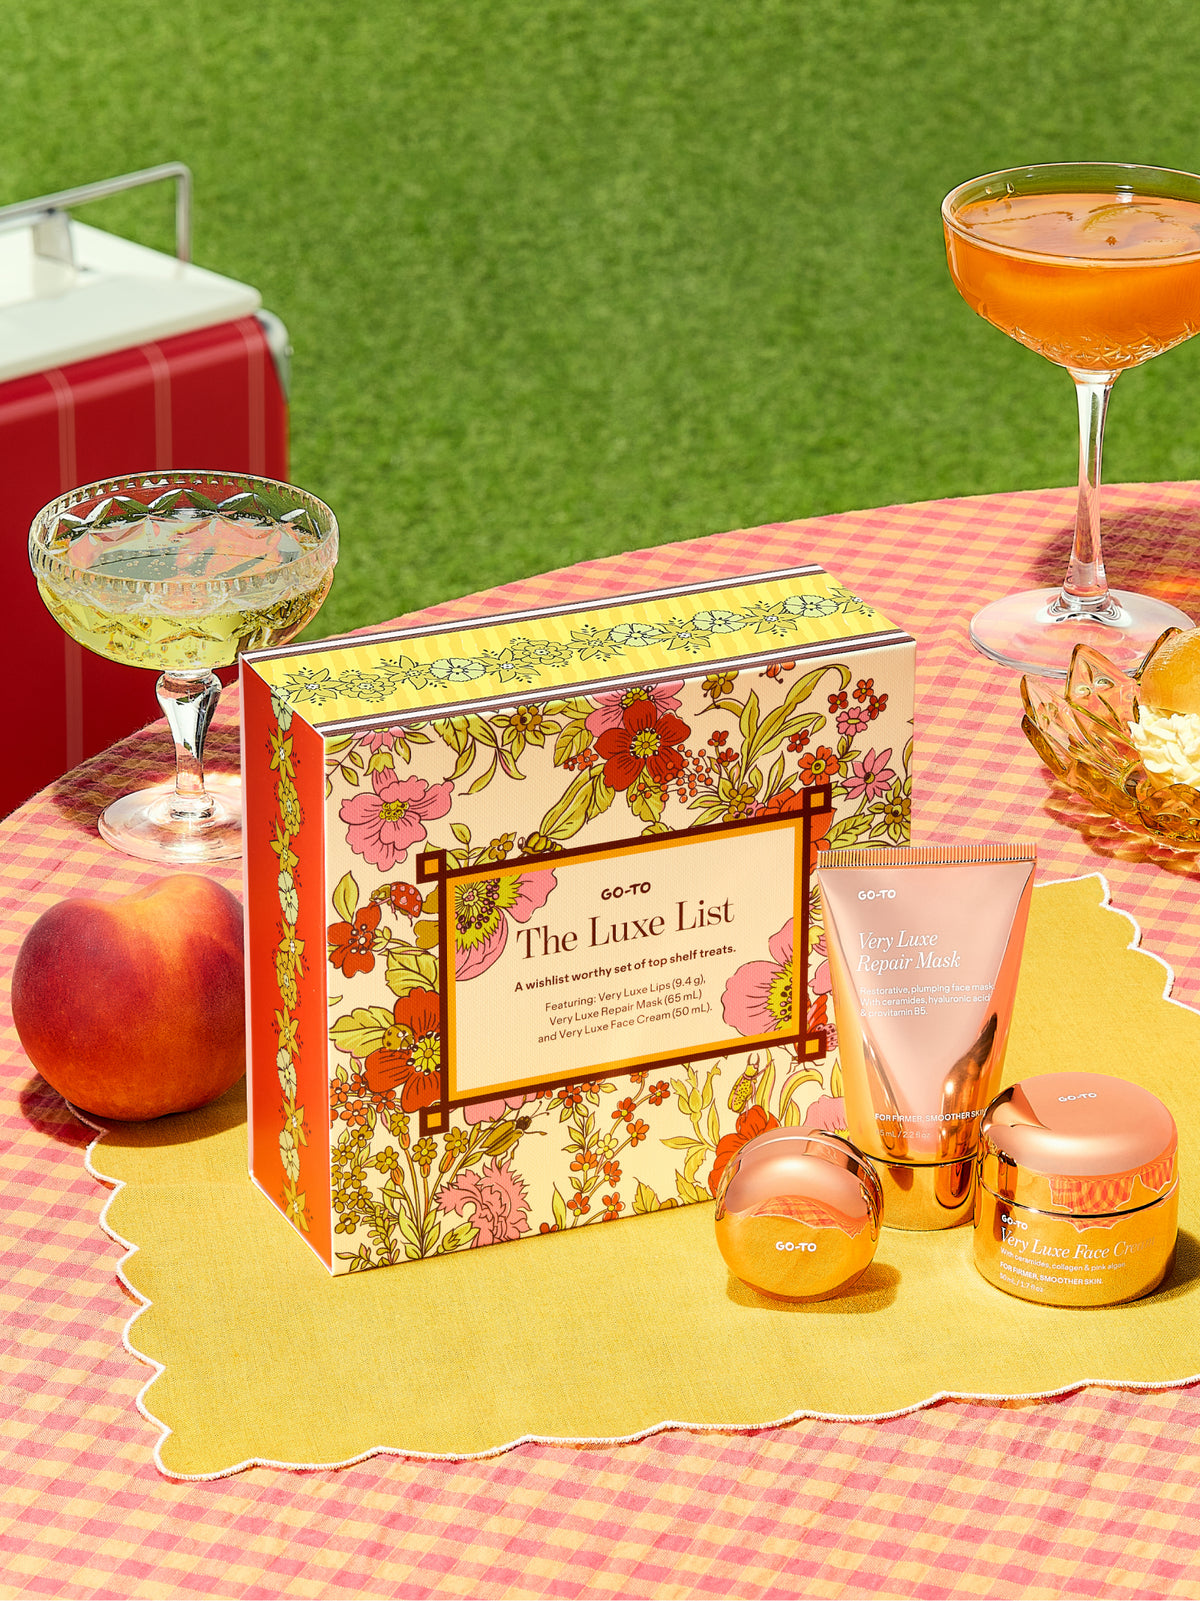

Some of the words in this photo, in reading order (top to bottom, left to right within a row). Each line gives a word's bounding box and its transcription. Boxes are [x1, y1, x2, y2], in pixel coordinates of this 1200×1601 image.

[600, 881, 651, 901] GO-TO
[857, 889, 897, 901] GO-TO
[516, 925, 578, 960] The
[587, 915, 665, 948] Luxe
[674, 897, 735, 932] List
[858, 931, 894, 953] Very
[896, 930, 939, 948] Luxe
[514, 981, 524, 993] A
[526, 973, 570, 991] wishlist
[571, 965, 612, 983] worthy
[614, 962, 633, 975] set
[634, 958, 647, 971] of
[648, 957, 668, 971] top
[669, 947, 698, 964] shelf
[699, 943, 737, 959] treats.
[856, 954, 913, 976] Repair
[915, 950, 961, 969] Mask
[545, 995, 597, 1013] Featuring:
[598, 990, 622, 1004] Very
[623, 986, 648, 999] Luxe
[650, 982, 671, 995] Lips
[672, 977, 692, 991] (9.4
[860, 985, 910, 995] Restorative,
[911, 984, 950, 994] plumping
[951, 983, 971, 992] face
[549, 1013, 573, 1028] Very
[574, 1009, 599, 1023] Luxe
[601, 1003, 634, 1020] Repair
[636, 997, 663, 1011] Mask
[664, 992, 682, 1007] (65
[683, 988, 703, 1003] mL)
[860, 997, 881, 1006] With
[881, 995, 927, 1006] ceramides,
[928, 994, 971, 1005] hyaluronic
[972, 993, 991, 1002] acid
[538, 1031, 557, 1043] and
[559, 1026, 583, 1041] Very
[584, 1021, 609, 1035] Luxe
[610, 1017, 635, 1030] Face
[636, 1010, 671, 1025] Cream
[672, 1005, 690, 1020] (50
[691, 1001, 713, 1016] mL).
[860, 1008, 867, 1017] &
[868, 1008, 913, 1018] provitamin
[914, 1006, 928, 1016] B5.
[1058, 1092, 1097, 1102] GO-TO
[874, 1112, 892, 1122] FOR
[925, 1111, 971, 1122] SMOOTHER
[1001, 1214, 1028, 1231] GO-TO
[775, 1241, 817, 1253] GO-TO
[1001, 1226, 1029, 1253] Very
[1031, 1238, 1070, 1259] Luxe
[1072, 1243, 1110, 1260] Face
[1113, 1236, 1156, 1257] Cream
[1000, 1261, 1012, 1272] FOR
[1012, 1267, 1039, 1281] FIRMER,
[1040, 1274, 1083, 1285] SMOOTHER
[1014, 1254, 1051, 1269] ceramides,
[1052, 1263, 1083, 1272] collagen
[1091, 1263, 1106, 1272] pink
